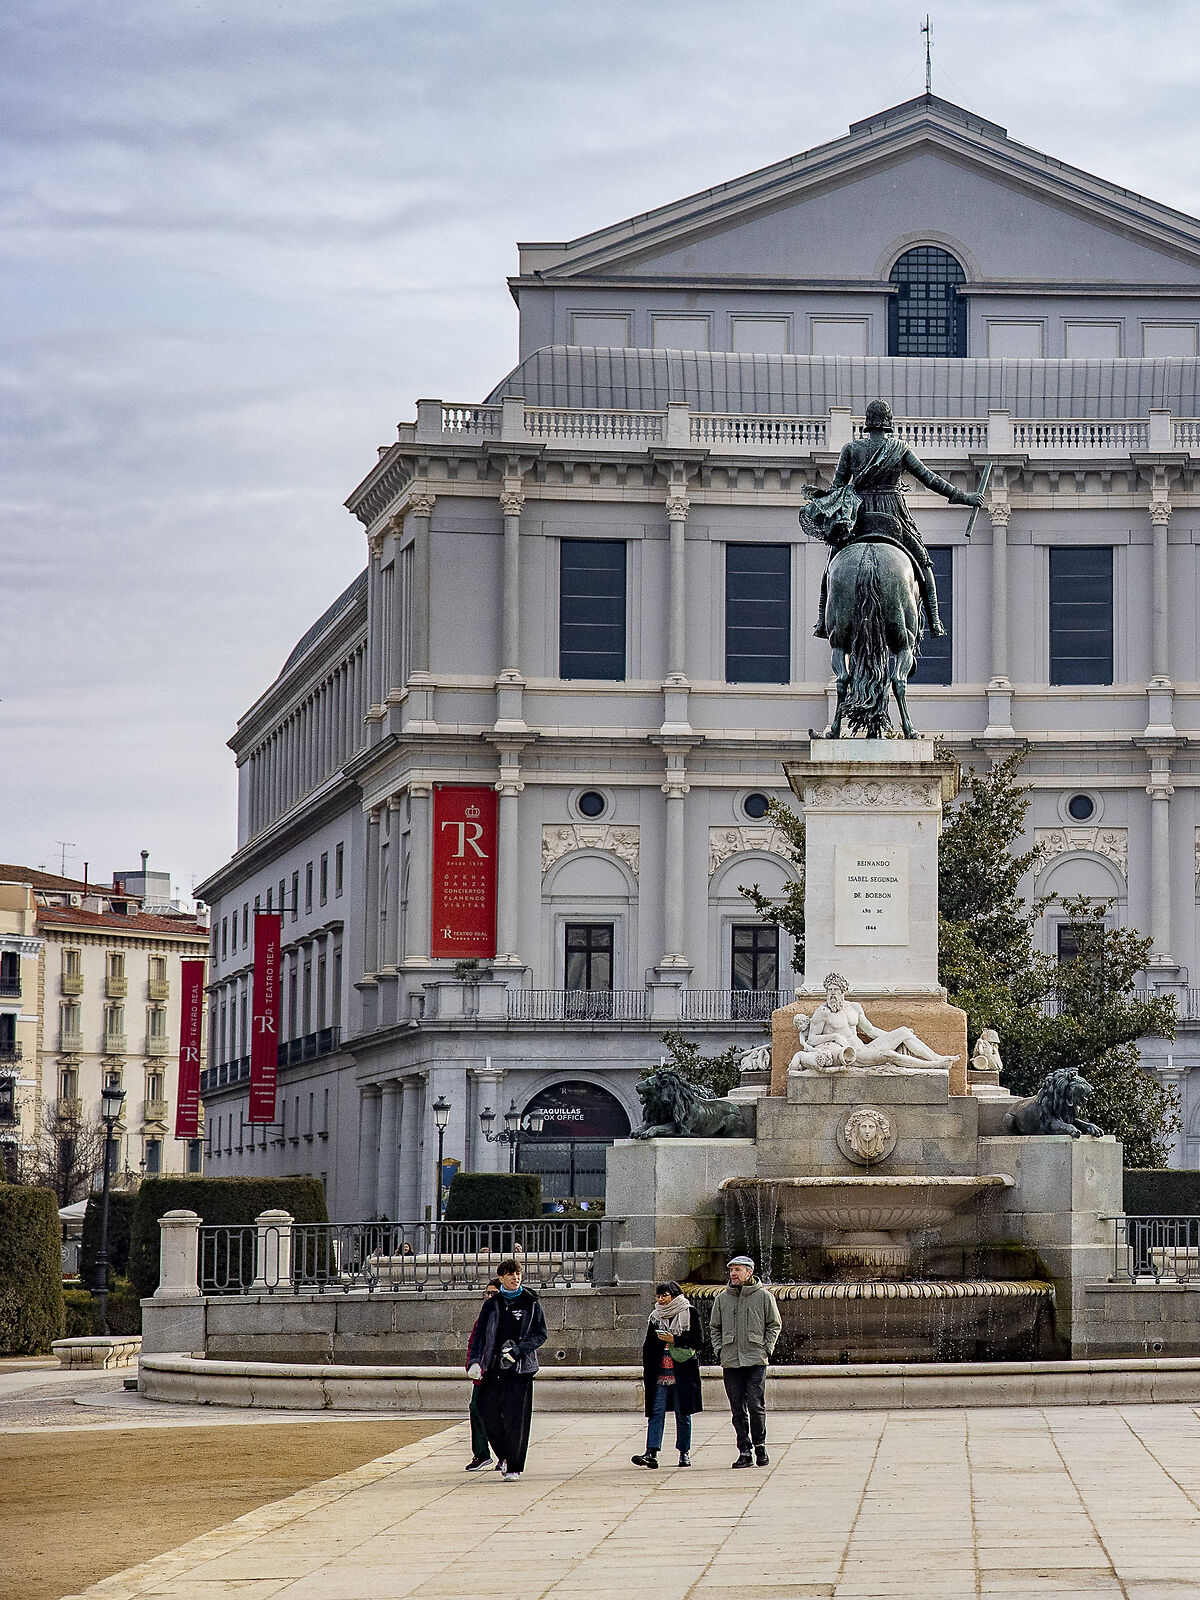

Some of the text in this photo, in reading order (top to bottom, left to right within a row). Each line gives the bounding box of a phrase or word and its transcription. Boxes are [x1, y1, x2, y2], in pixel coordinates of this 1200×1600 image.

[265, 941, 275, 1004] TEATRO REAL
[191, 984, 199, 1003] REAL
